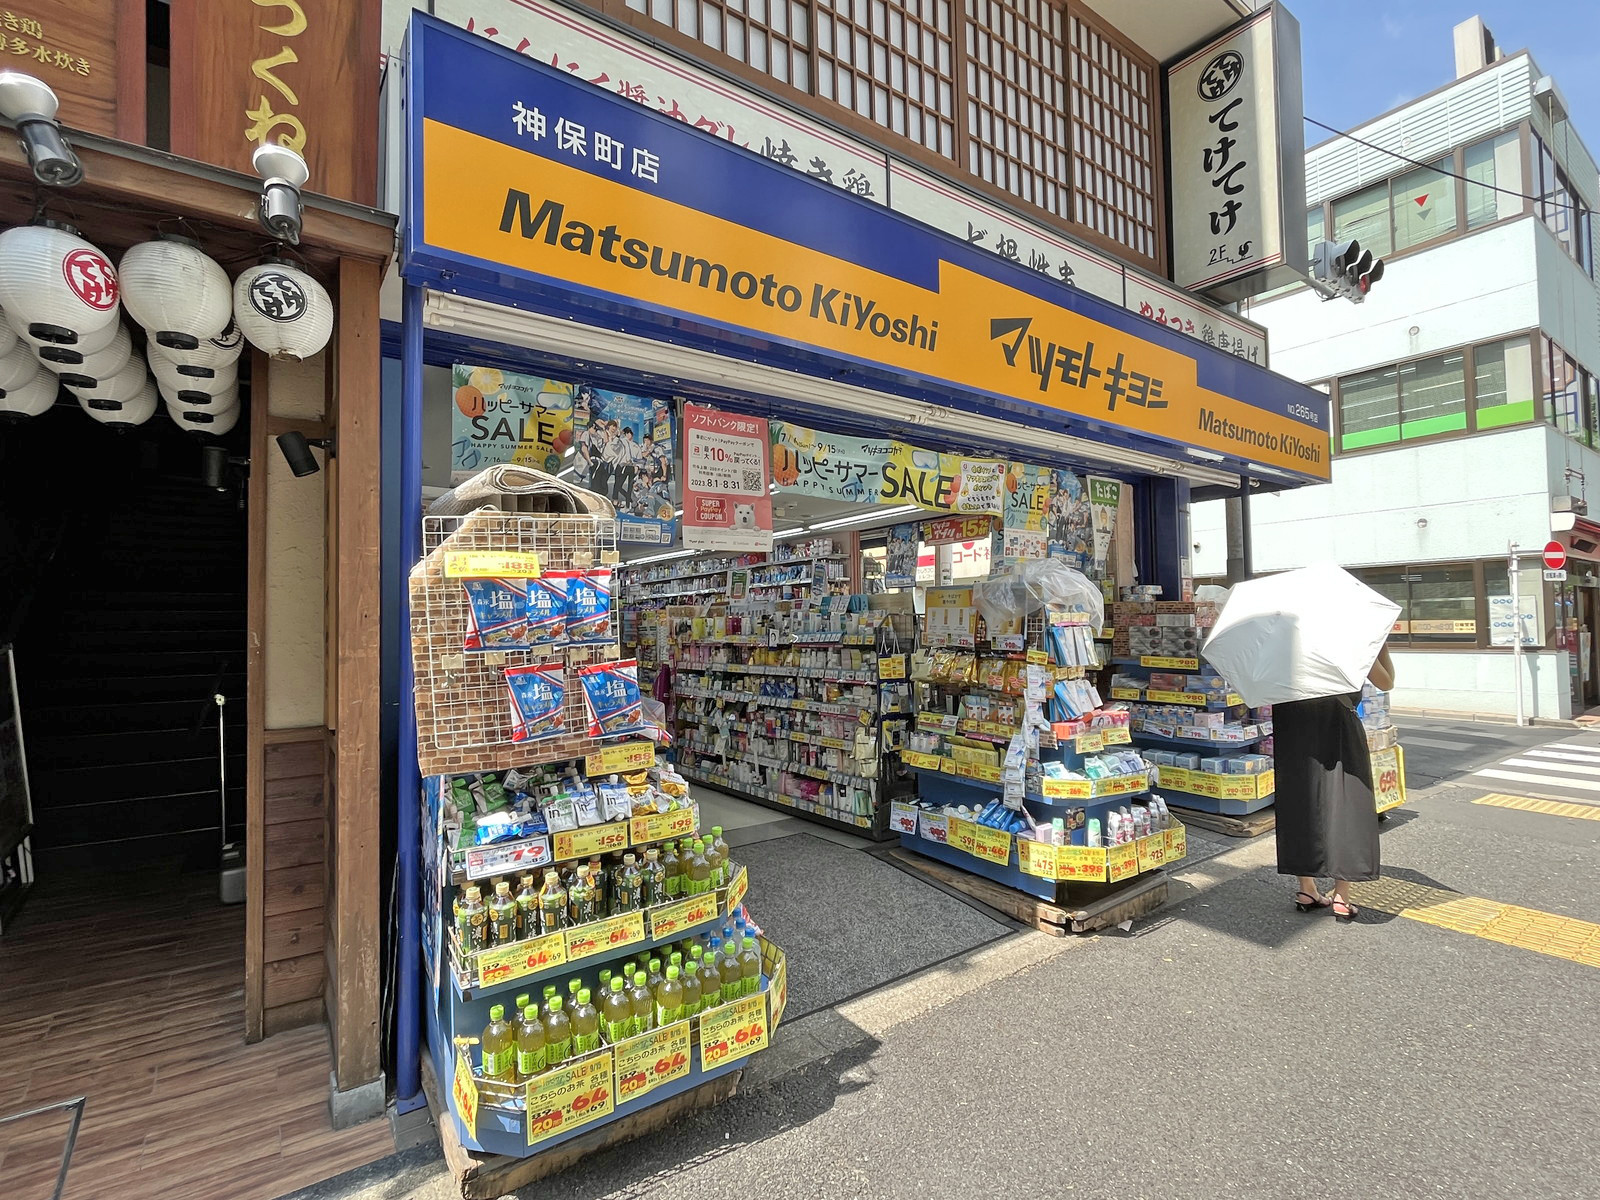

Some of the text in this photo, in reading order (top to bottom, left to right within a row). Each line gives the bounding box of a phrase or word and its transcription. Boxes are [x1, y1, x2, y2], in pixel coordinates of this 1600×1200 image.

[511, 101, 660, 184] 神保町店
[1202, 98, 1247, 236] てけてけ
[1209, 245, 1227, 263] 2F
[499, 188, 940, 352] Matsumoto KiYoshi
[990, 316, 1169, 412] マツモトキヨシ
[471, 396, 557, 418] ハッピーサマー
[470, 415, 556, 447] SALE
[1198, 408, 1321, 464] Matsumoto KiYoshi
[471, 442, 554, 454] HAPPY SUMMER SALE
[710, 447, 734, 463] 10%
[782, 448, 879, 484] ハッピーサマー
[880, 460, 955, 509] SALE
[1095, 481, 1118, 500] たばこ
[1010, 491, 1044, 511] SALE
[700, 512, 723, 520] COUPON
[490, 590, 513, 609] 塩
[529, 590, 552, 608] 塩
[575, 587, 597, 606] 塩
[533, 682, 553, 701] 塩
[606, 679, 627, 698] 塩
[606, 794, 617, 806] in
[549, 808, 560, 819] in
[672, 818, 692, 830] 198
[600, 834, 625, 845] 156
[1175, 842, 1185, 852] 925
[509, 846, 545, 862] 79
[1151, 849, 1164, 860] 925
[1036, 859, 1054, 871] 475
[1081, 864, 1104, 873] 398
[1123, 859, 1136, 869] 398
[687, 907, 704, 923] 64
[609, 928, 629, 944] 64
[527, 951, 548, 968] 64
[551, 952, 562, 961] 69
[729, 1003, 746, 1016] SALE
[702, 1008, 762, 1036] こちらのお茶 各種
[649, 1031, 669, 1046] SALE
[735, 1023, 764, 1043] 64
[618, 1037, 687, 1068] こちらのお茶 各種
[705, 1036, 761, 1063] 20 69
[654, 1052, 688, 1074] 64
[565, 1066, 587, 1081] SALE
[620, 1065, 683, 1095] 20 69
[530, 1070, 608, 1105] こちらのお茶 各種
[571, 1087, 609, 1111] 64
[533, 1101, 605, 1135] 20 69
